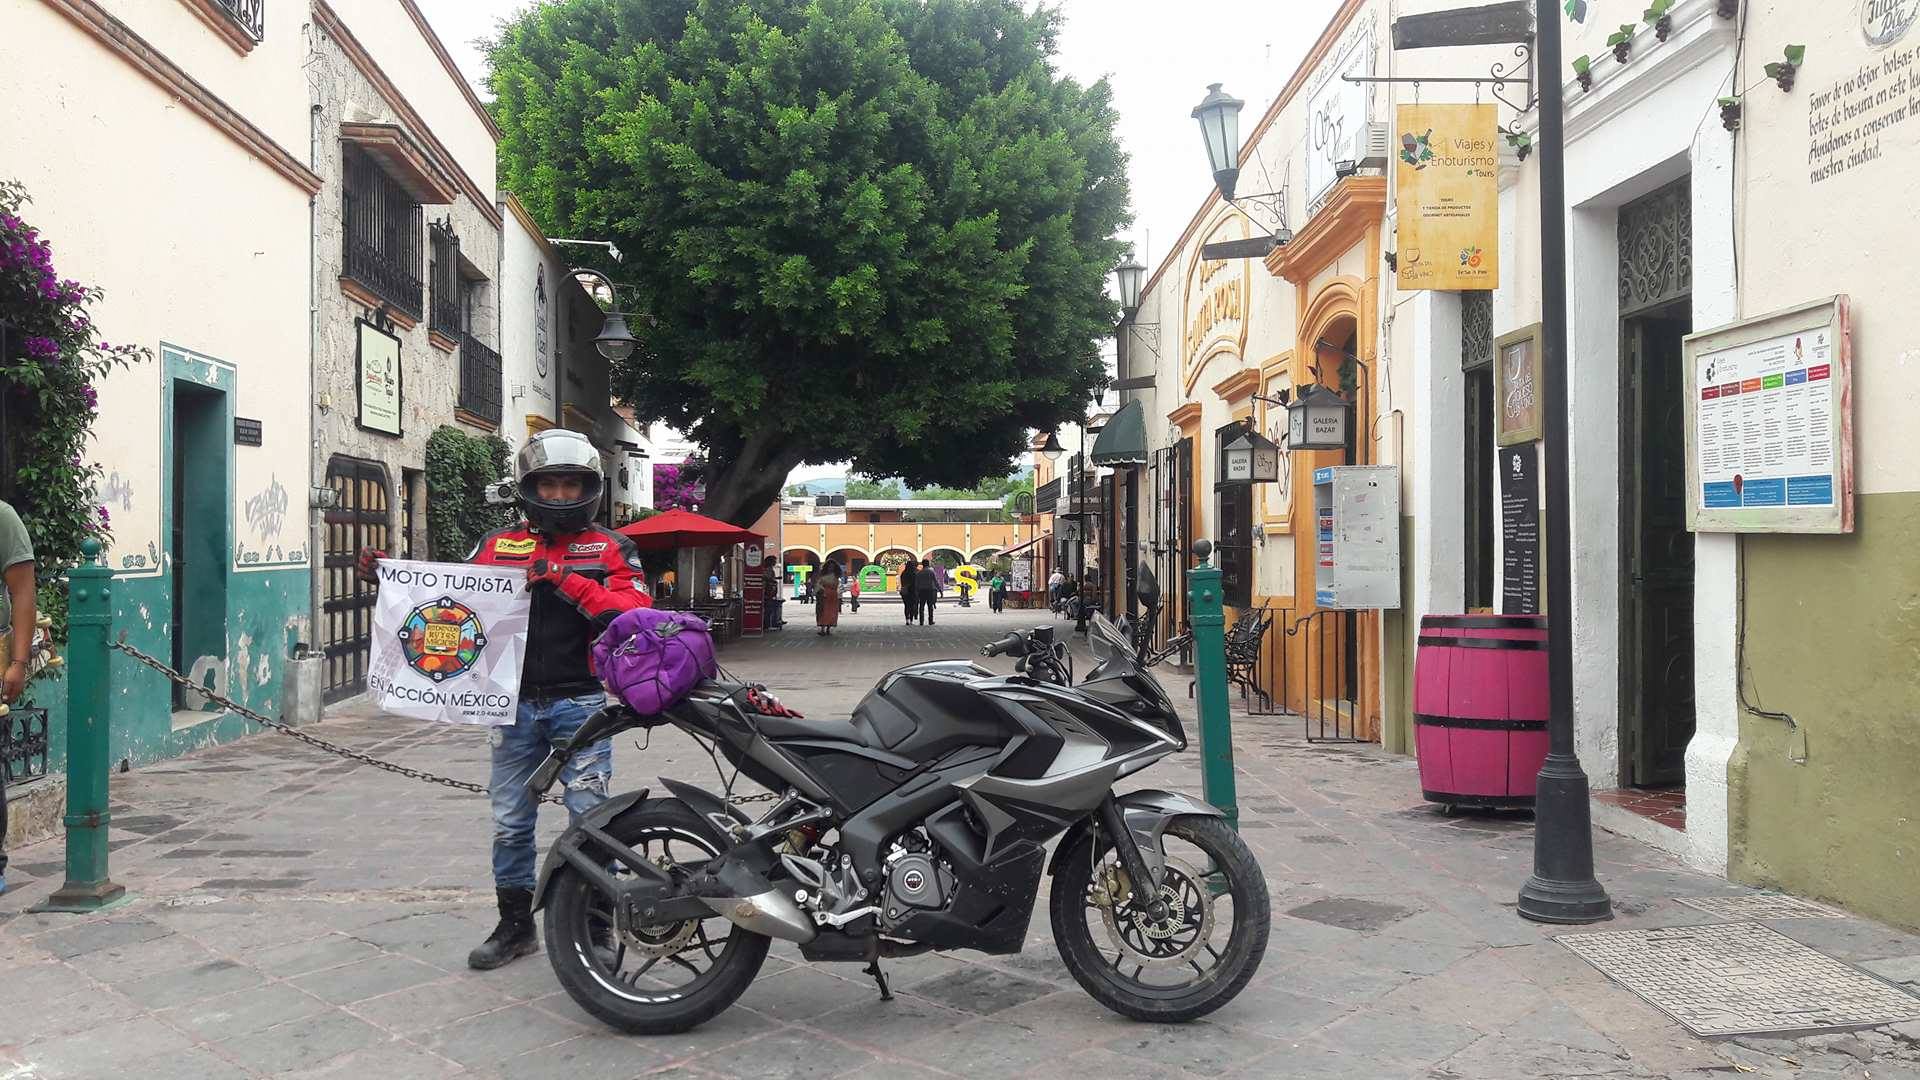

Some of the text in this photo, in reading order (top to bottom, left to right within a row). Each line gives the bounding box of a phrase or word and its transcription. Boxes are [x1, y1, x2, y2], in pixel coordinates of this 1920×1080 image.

[1809, 51, 1913, 115] Favor de no dejar bolsas
[1809, 114, 1830, 137] botes
[1831, 105, 1841, 127] de
[1843, 100, 1875, 122] basura
[1876, 88, 1888, 106] en
[1889, 73, 1907, 100] este
[1853, 130, 1861, 142] a
[1862, 105, 1907, 138] conservar
[1454, 138, 1495, 153] Viajes y
[1431, 156, 1495, 167] Enoturismo
[1810, 137, 1882, 185] nuestra ciudad.
[1474, 169, 1495, 177] Tours
[577, 542, 604, 551] Castrol
[381, 566, 513, 594] MOTO TURISTA
[400, 631, 409, 639] O
[476, 638, 485, 646] E
[433, 672, 443, 680] S
[370, 675, 510, 709] EN ACCIÓN MÉXICO
